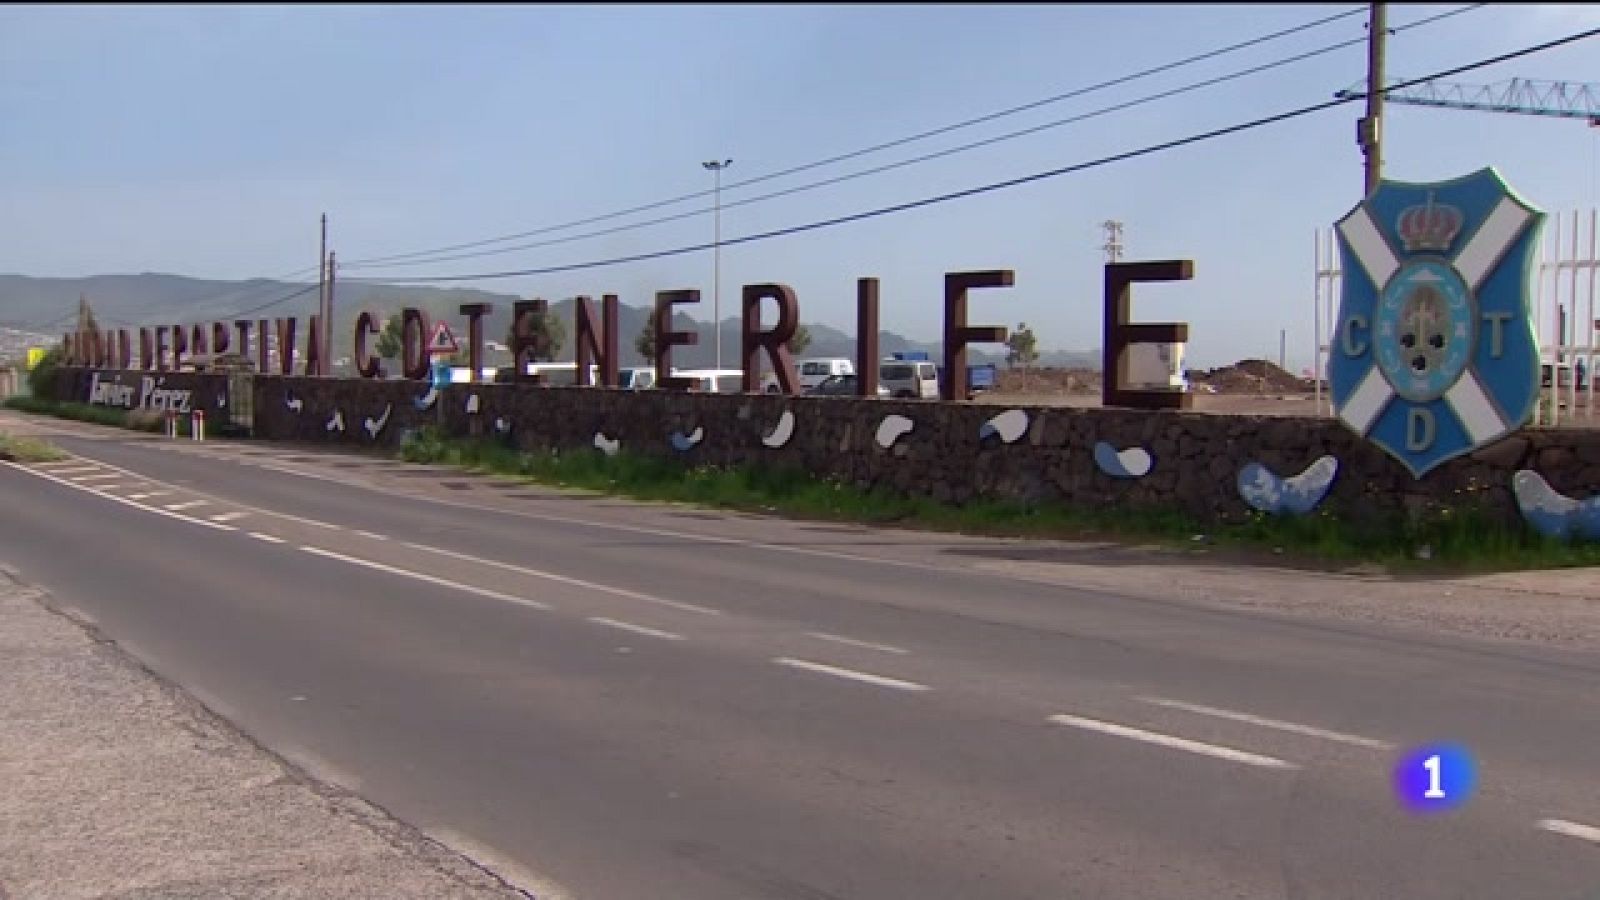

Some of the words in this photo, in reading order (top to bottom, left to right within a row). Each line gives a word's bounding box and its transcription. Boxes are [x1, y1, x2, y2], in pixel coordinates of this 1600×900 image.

[354, 307, 431, 380] CD
[459, 259, 1195, 410] TENERIFE
[1342, 314, 1368, 357] C
[1481, 312, 1514, 359] T
[1406, 407, 1436, 451] D
